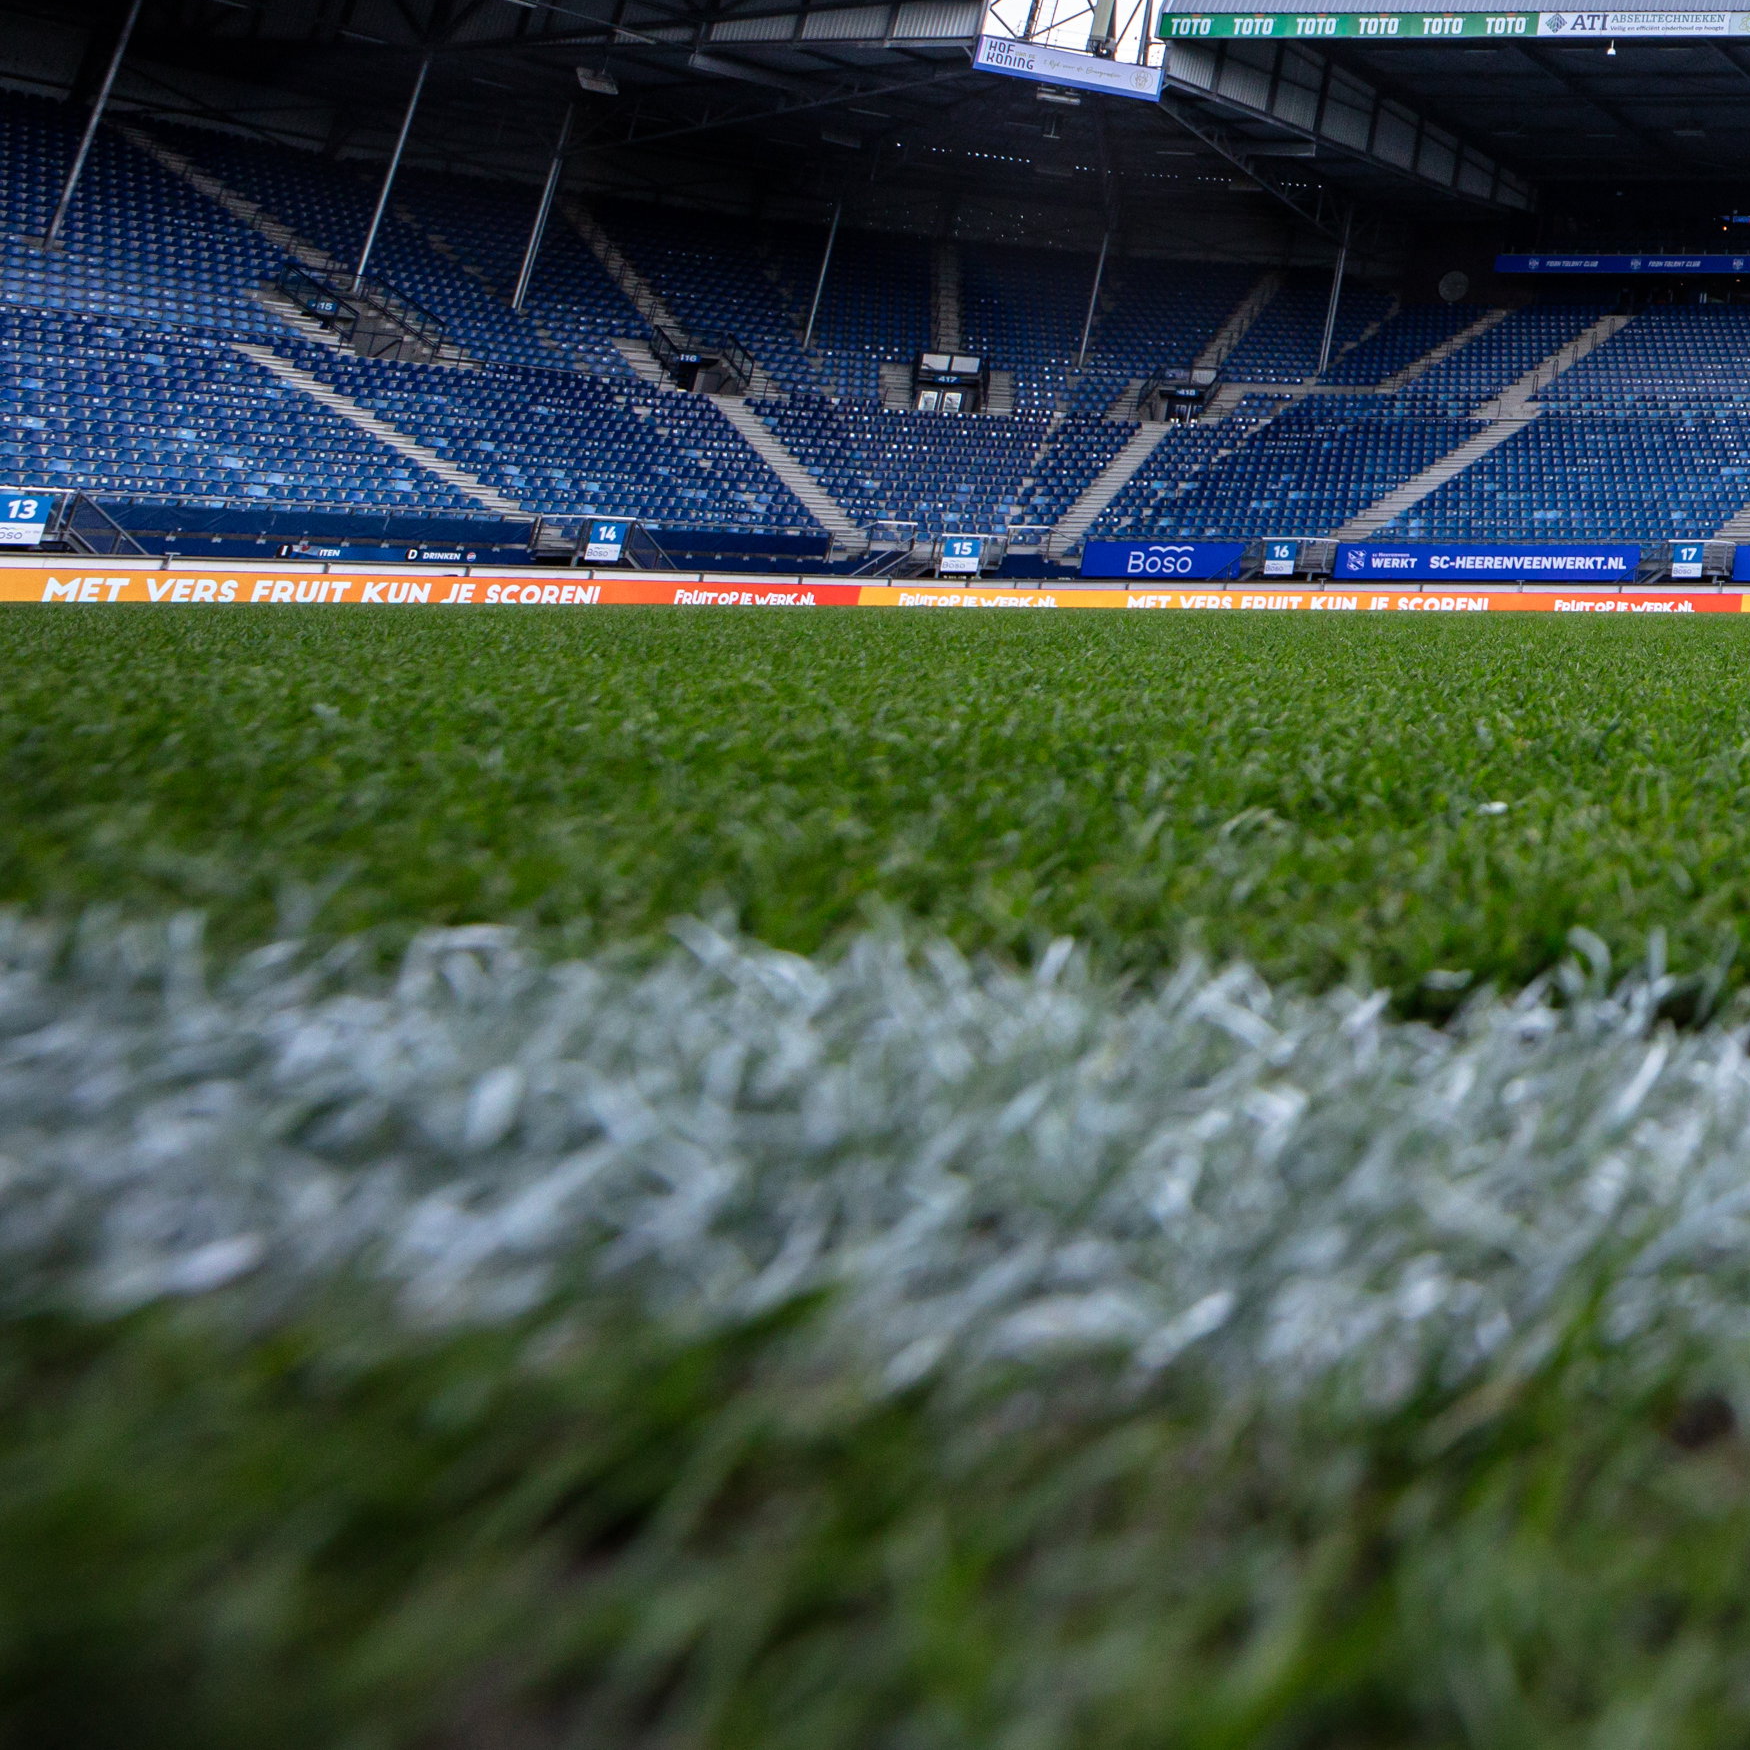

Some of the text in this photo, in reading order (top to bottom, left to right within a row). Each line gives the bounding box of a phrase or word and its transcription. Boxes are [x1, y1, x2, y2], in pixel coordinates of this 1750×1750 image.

[1486, 17, 1526, 34] TOTO
[1570, 14, 1610, 31] ATI
[1611, 13, 1725, 23] ABSEILTECHNIEKEN
[1171, 17, 1211, 35] TOTO
[1297, 17, 1337, 35] TOTO
[1423, 17, 1463, 35] TOTO
[989, 40, 1015, 55] HOF
[986, 52, 1035, 70] KONING
[8, 499, 39, 519] 13
[599, 526, 617, 541] 14
[319, 549, 341, 557] ITEN
[953, 542, 972, 555] 15
[1274, 545, 1290, 558] 16
[1681, 547, 1697, 560] 17
[422, 552, 461, 561] DRINKEN
[1127, 552, 1192, 574] Boso
[1371, 557, 1418, 569] WERKT
[1429, 556, 1626, 570] SC-HEERENVEENWERKT.NL
[42, 578, 130, 602] MET
[147, 578, 238, 602] VERS
[251, 580, 352, 602] FRUIT
[361, 582, 431, 603] KUN
[441, 584, 475, 603] JE
